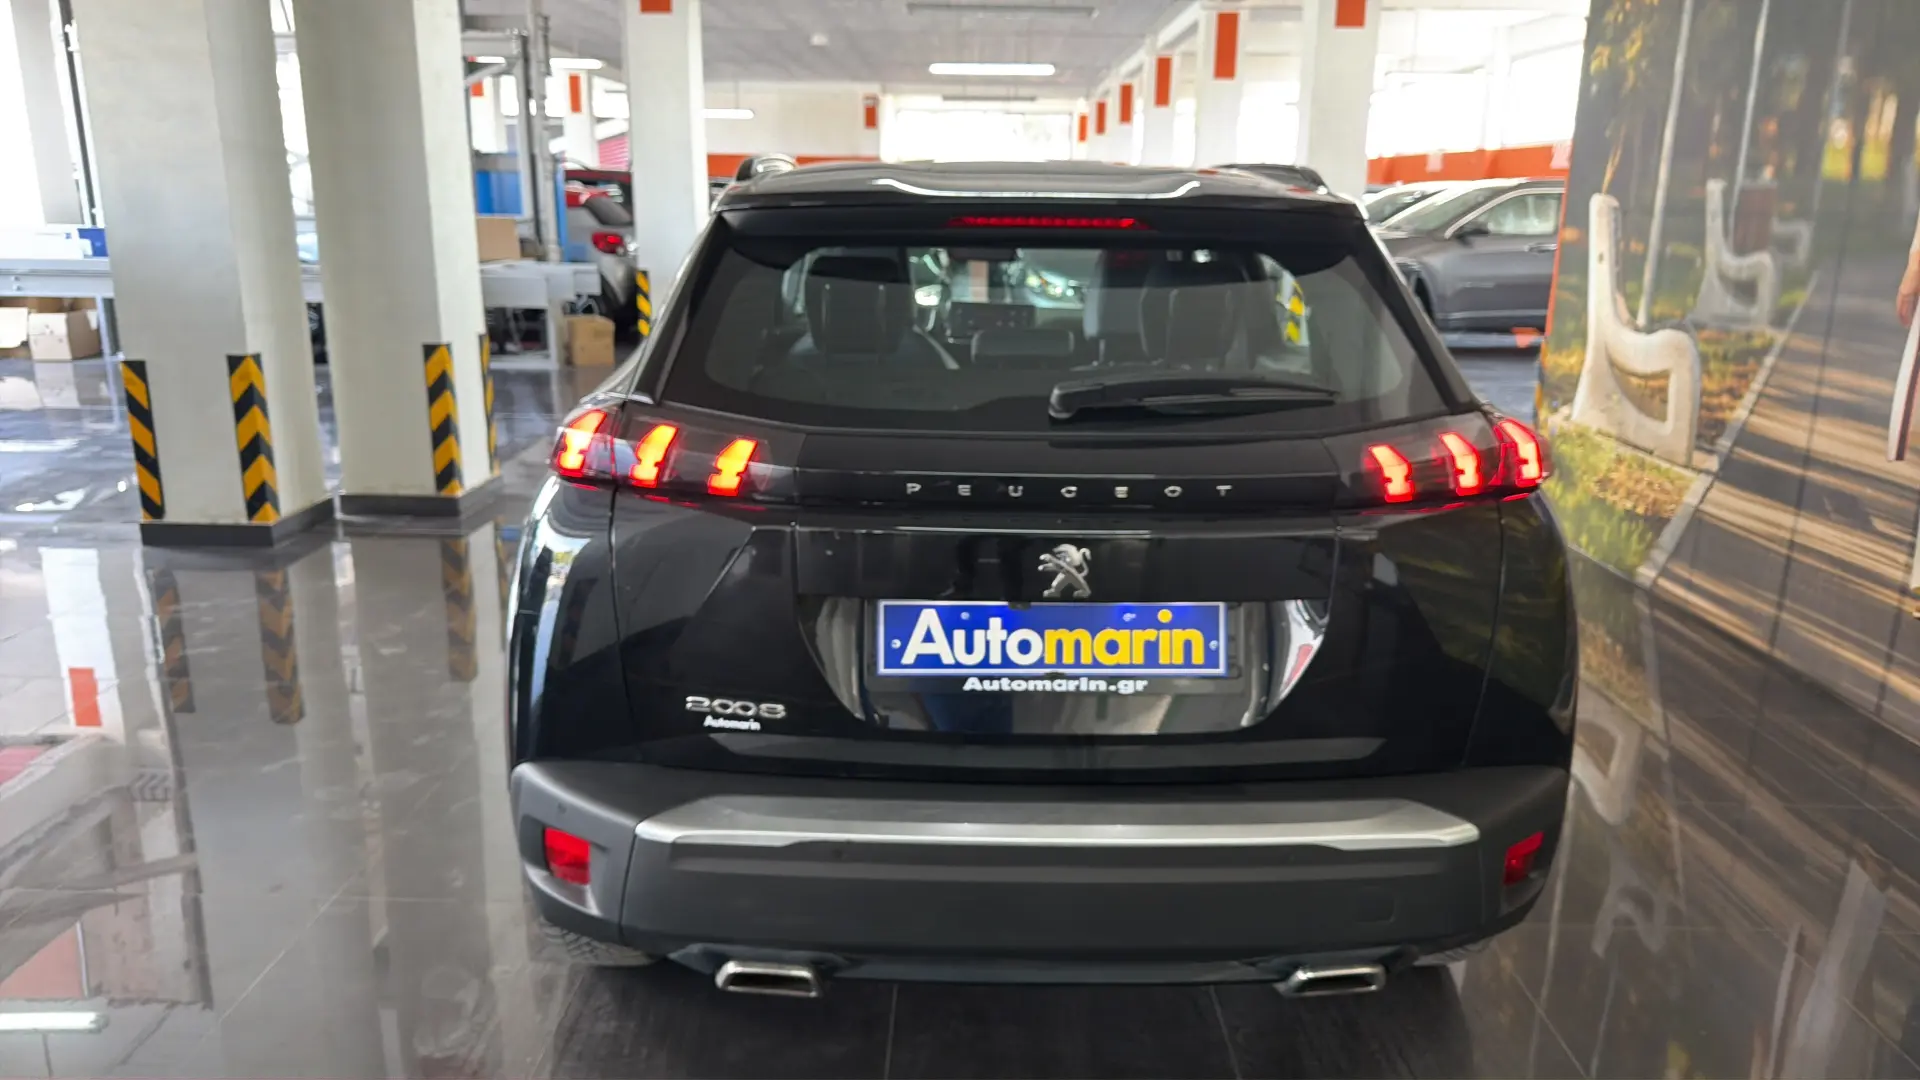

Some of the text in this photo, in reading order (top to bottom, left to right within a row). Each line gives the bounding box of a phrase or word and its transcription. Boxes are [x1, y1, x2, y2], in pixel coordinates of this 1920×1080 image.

[906, 482, 1233, 498] PEUGEOT
[901, 608, 1205, 666] Automarin
[962, 676, 1148, 694] Automarin.gr
[685, 696, 786, 718] 2008
